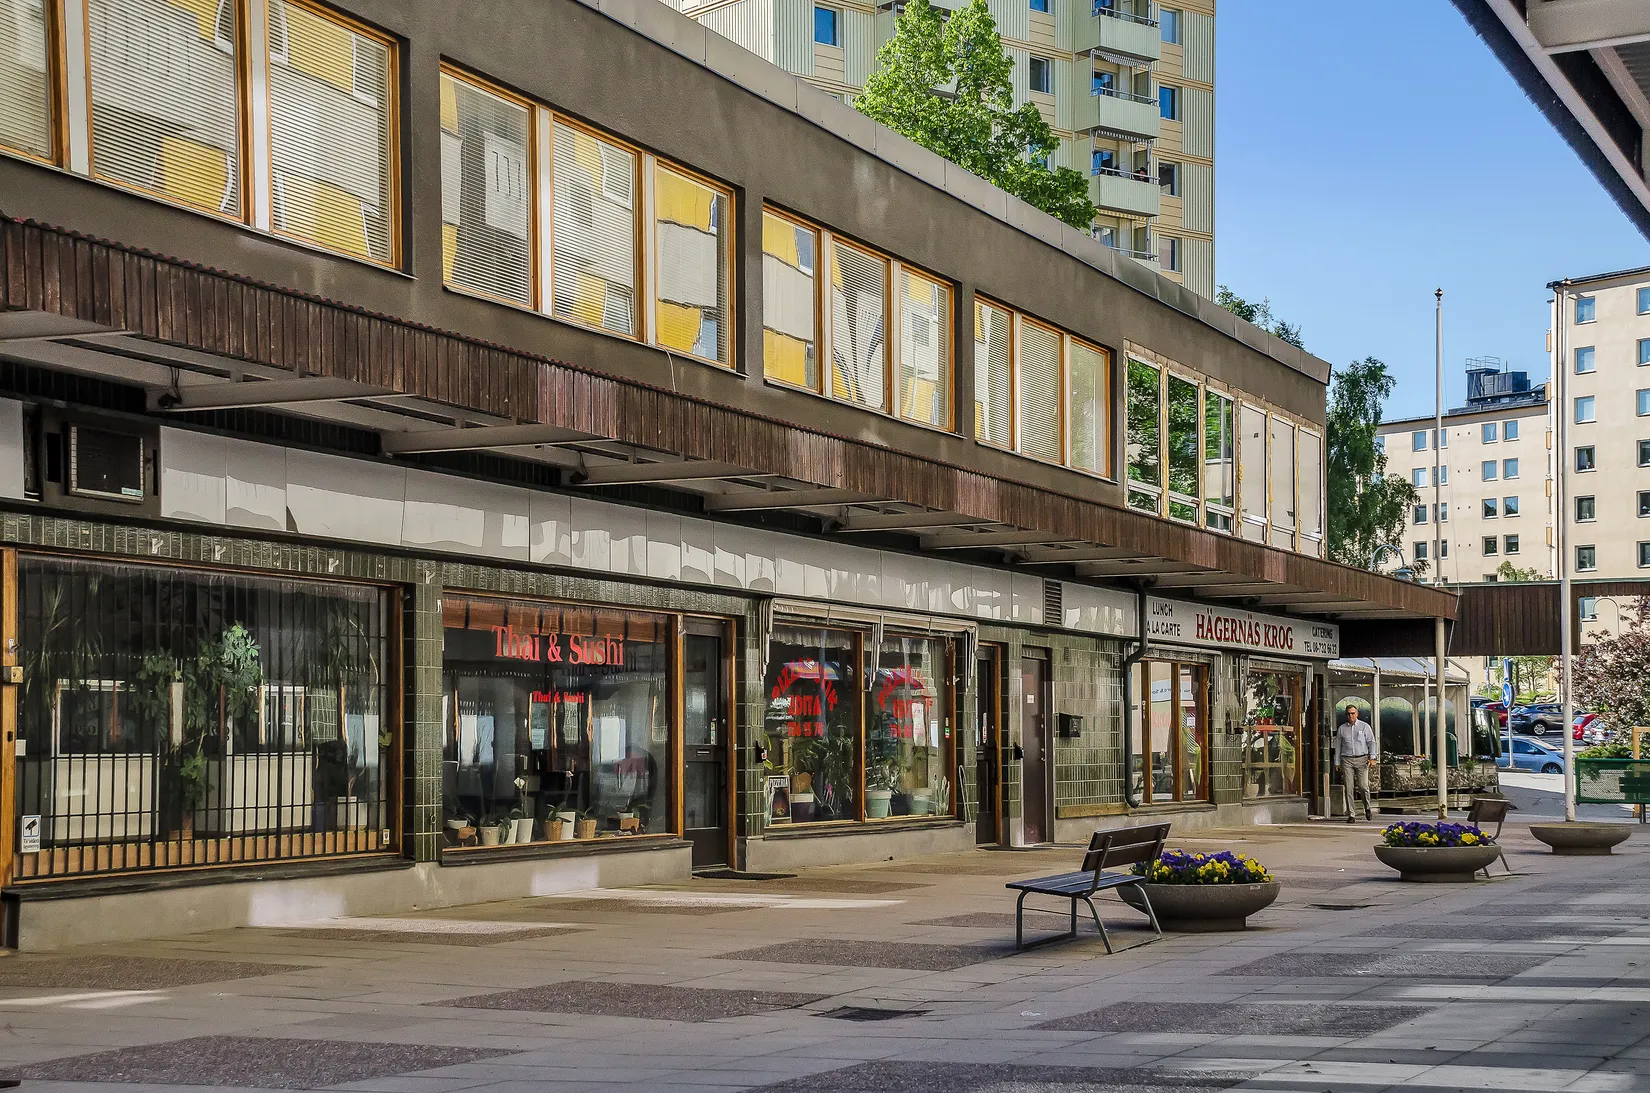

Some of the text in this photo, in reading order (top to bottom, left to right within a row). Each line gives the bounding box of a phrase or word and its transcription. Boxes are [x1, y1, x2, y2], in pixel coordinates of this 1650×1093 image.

[1152, 601, 1173, 617] LUNCH
[1152, 621, 1159, 634] LA
[1161, 621, 1181, 637] CARTE
[1195, 608, 1294, 650] HÄGERNÄS KROG
[1311, 625, 1333, 639] CATERING
[491, 624, 540, 661] Thai
[547, 632, 563, 662] &
[569, 633, 624, 666] Sushi
[533, 690, 551, 702] Thai
[563, 691, 585, 703] Sushi
[787, 694, 822, 716] EDITA
